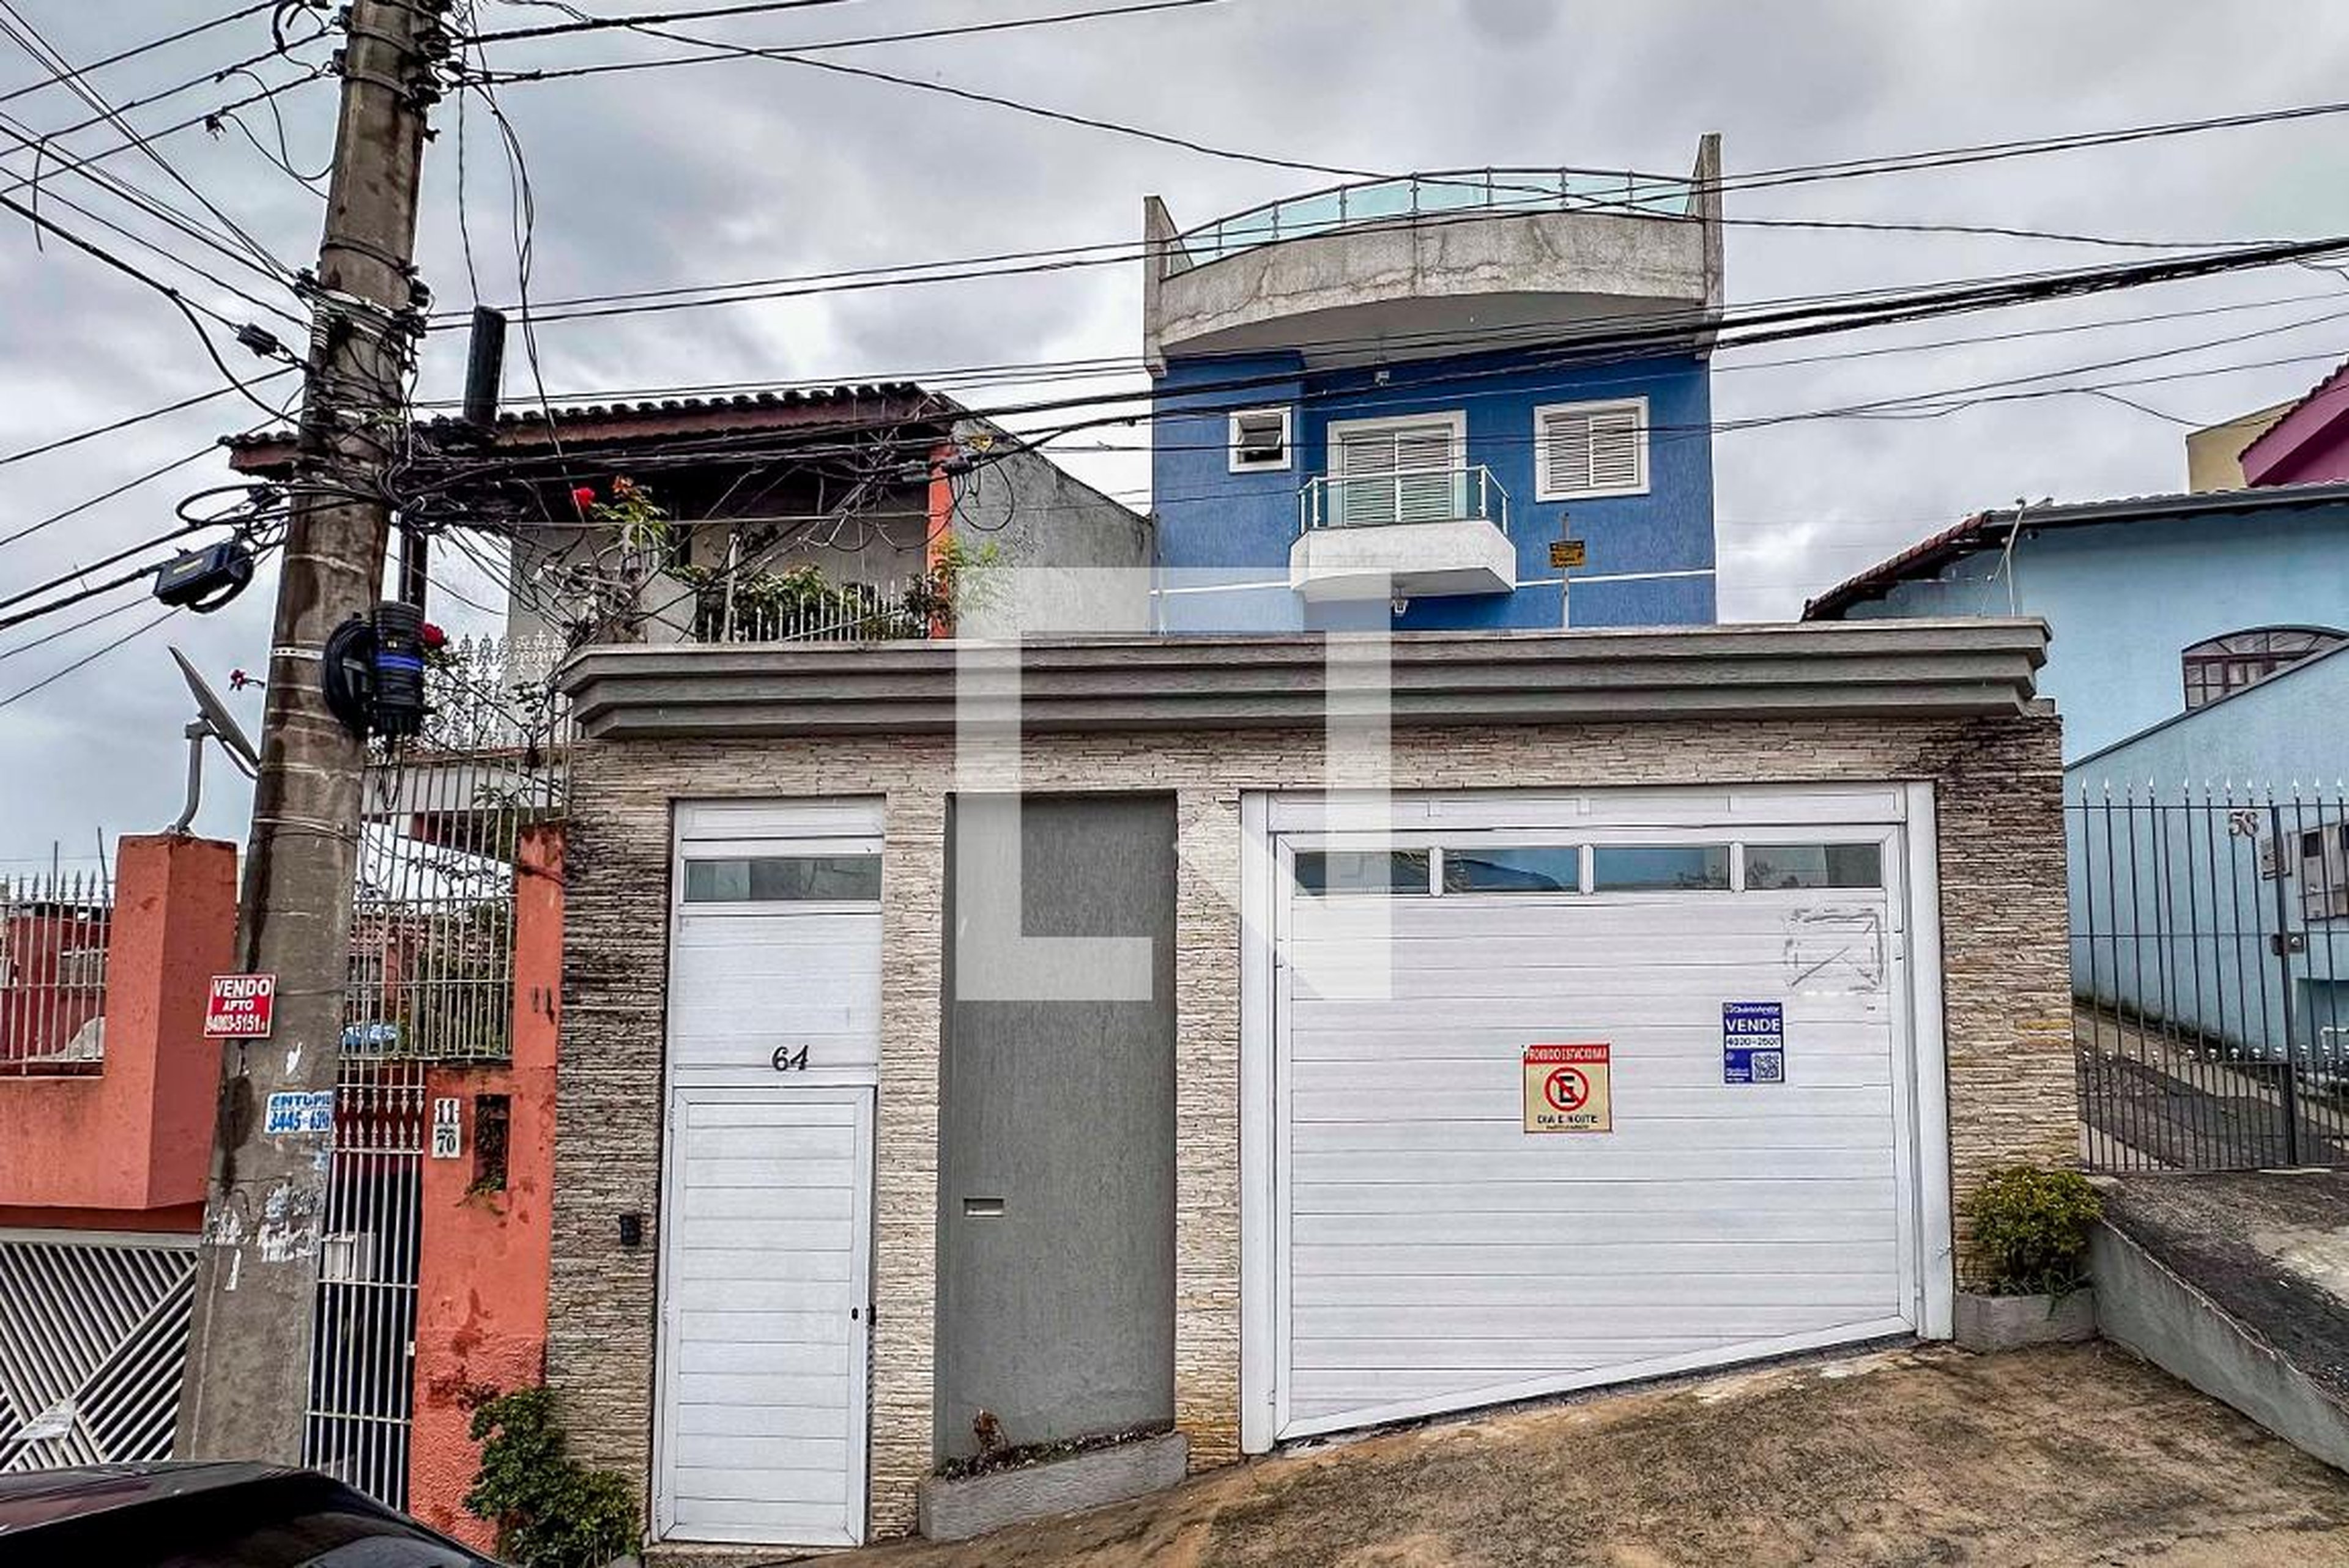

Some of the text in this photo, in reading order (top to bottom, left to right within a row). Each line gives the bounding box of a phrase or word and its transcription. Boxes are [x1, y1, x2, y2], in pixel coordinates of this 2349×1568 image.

[2228, 810, 2259, 838] 58
[212, 979, 270, 997] VENDO
[222, 999, 255, 1011] APTO
[1725, 1018, 1781, 1032] VENDE
[771, 1045, 809, 1071] 64
[1537, 1114, 1598, 1124] DIA E NOITE
[436, 1134, 456, 1153] 70
